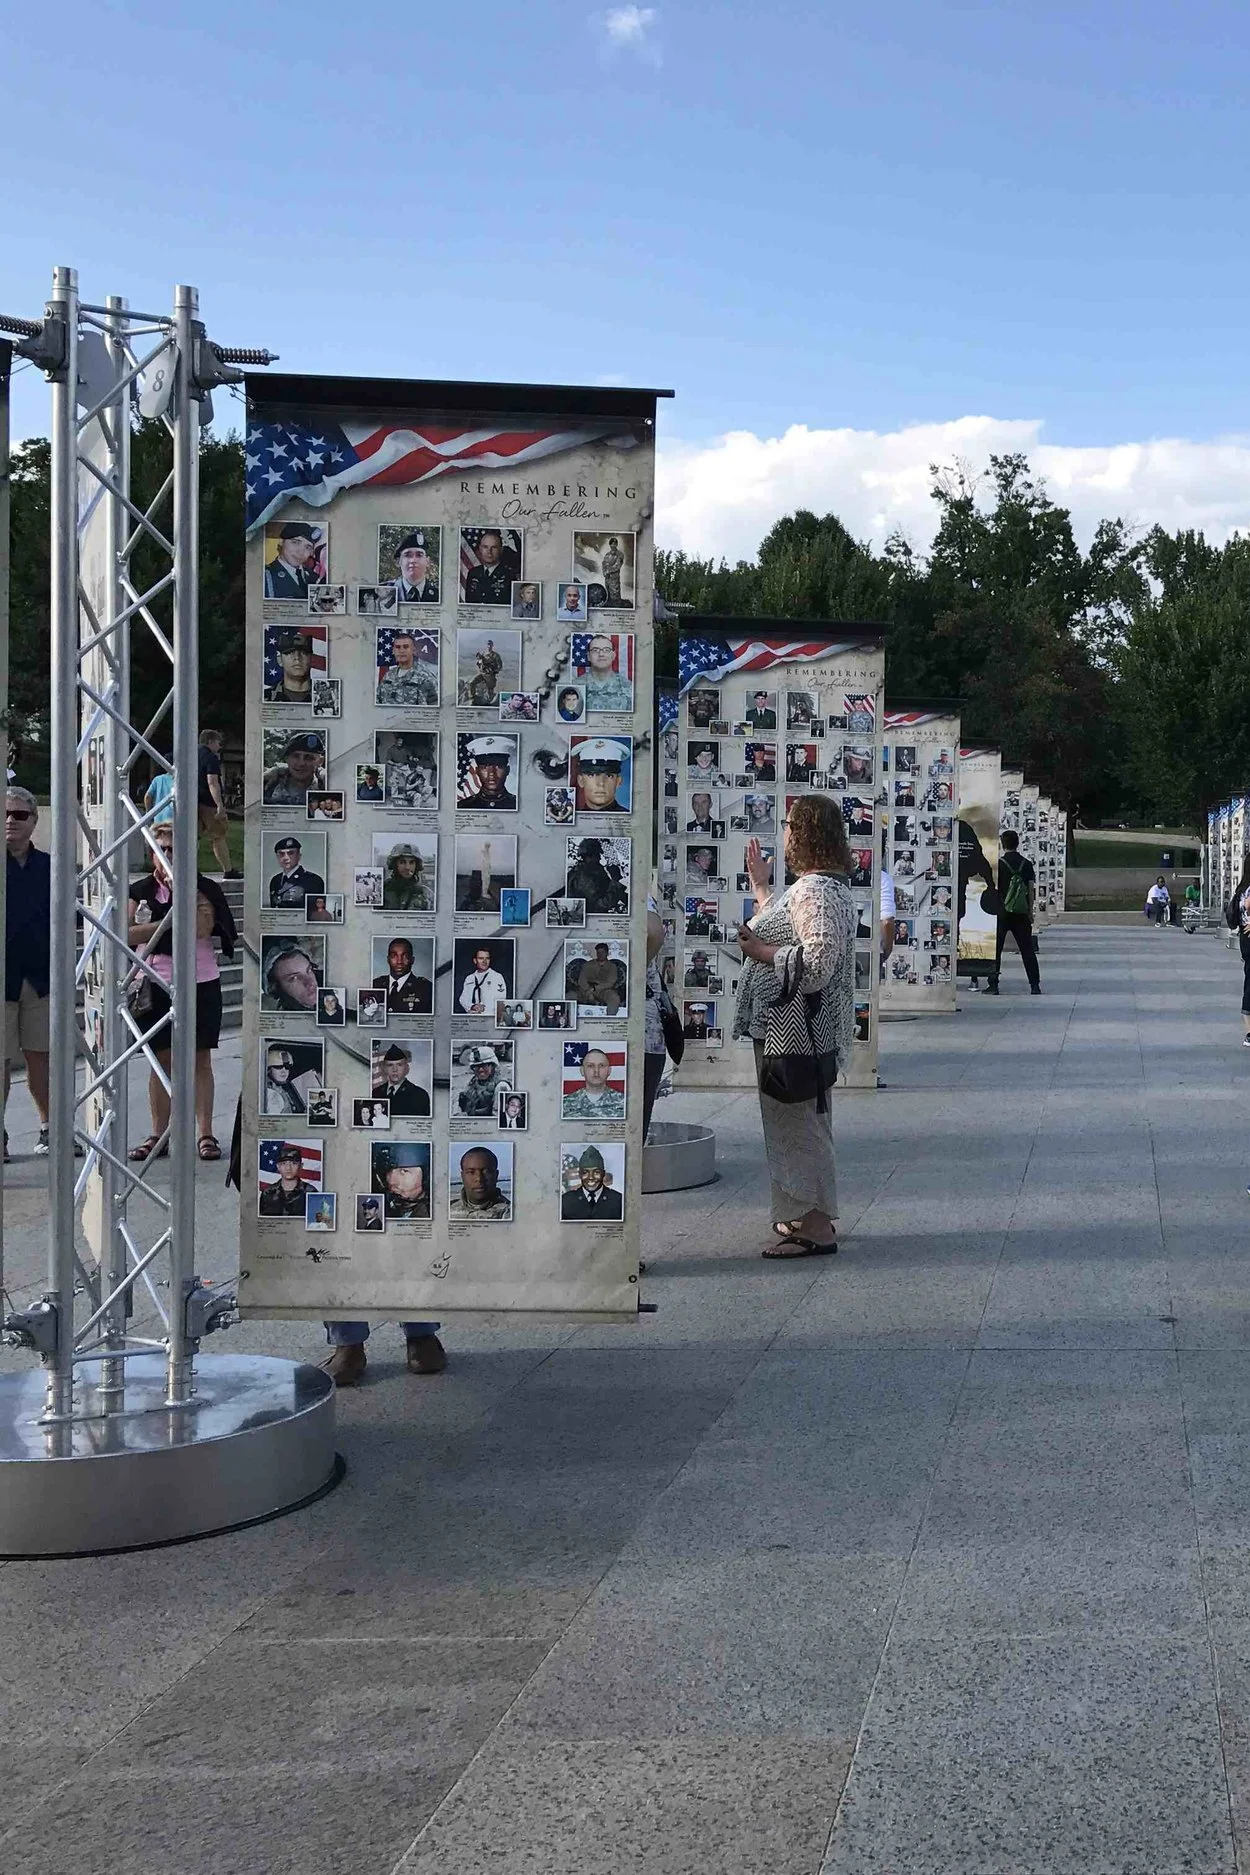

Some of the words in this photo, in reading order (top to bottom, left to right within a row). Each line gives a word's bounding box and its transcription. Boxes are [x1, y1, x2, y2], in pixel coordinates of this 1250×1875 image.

[153, 370, 165, 392] 8
[460, 481, 636, 499] REMEMBERING
[502, 499, 537, 519] Our
[542, 501, 600, 520] Fallen
[786, 669, 876, 678] REMEMBERING
